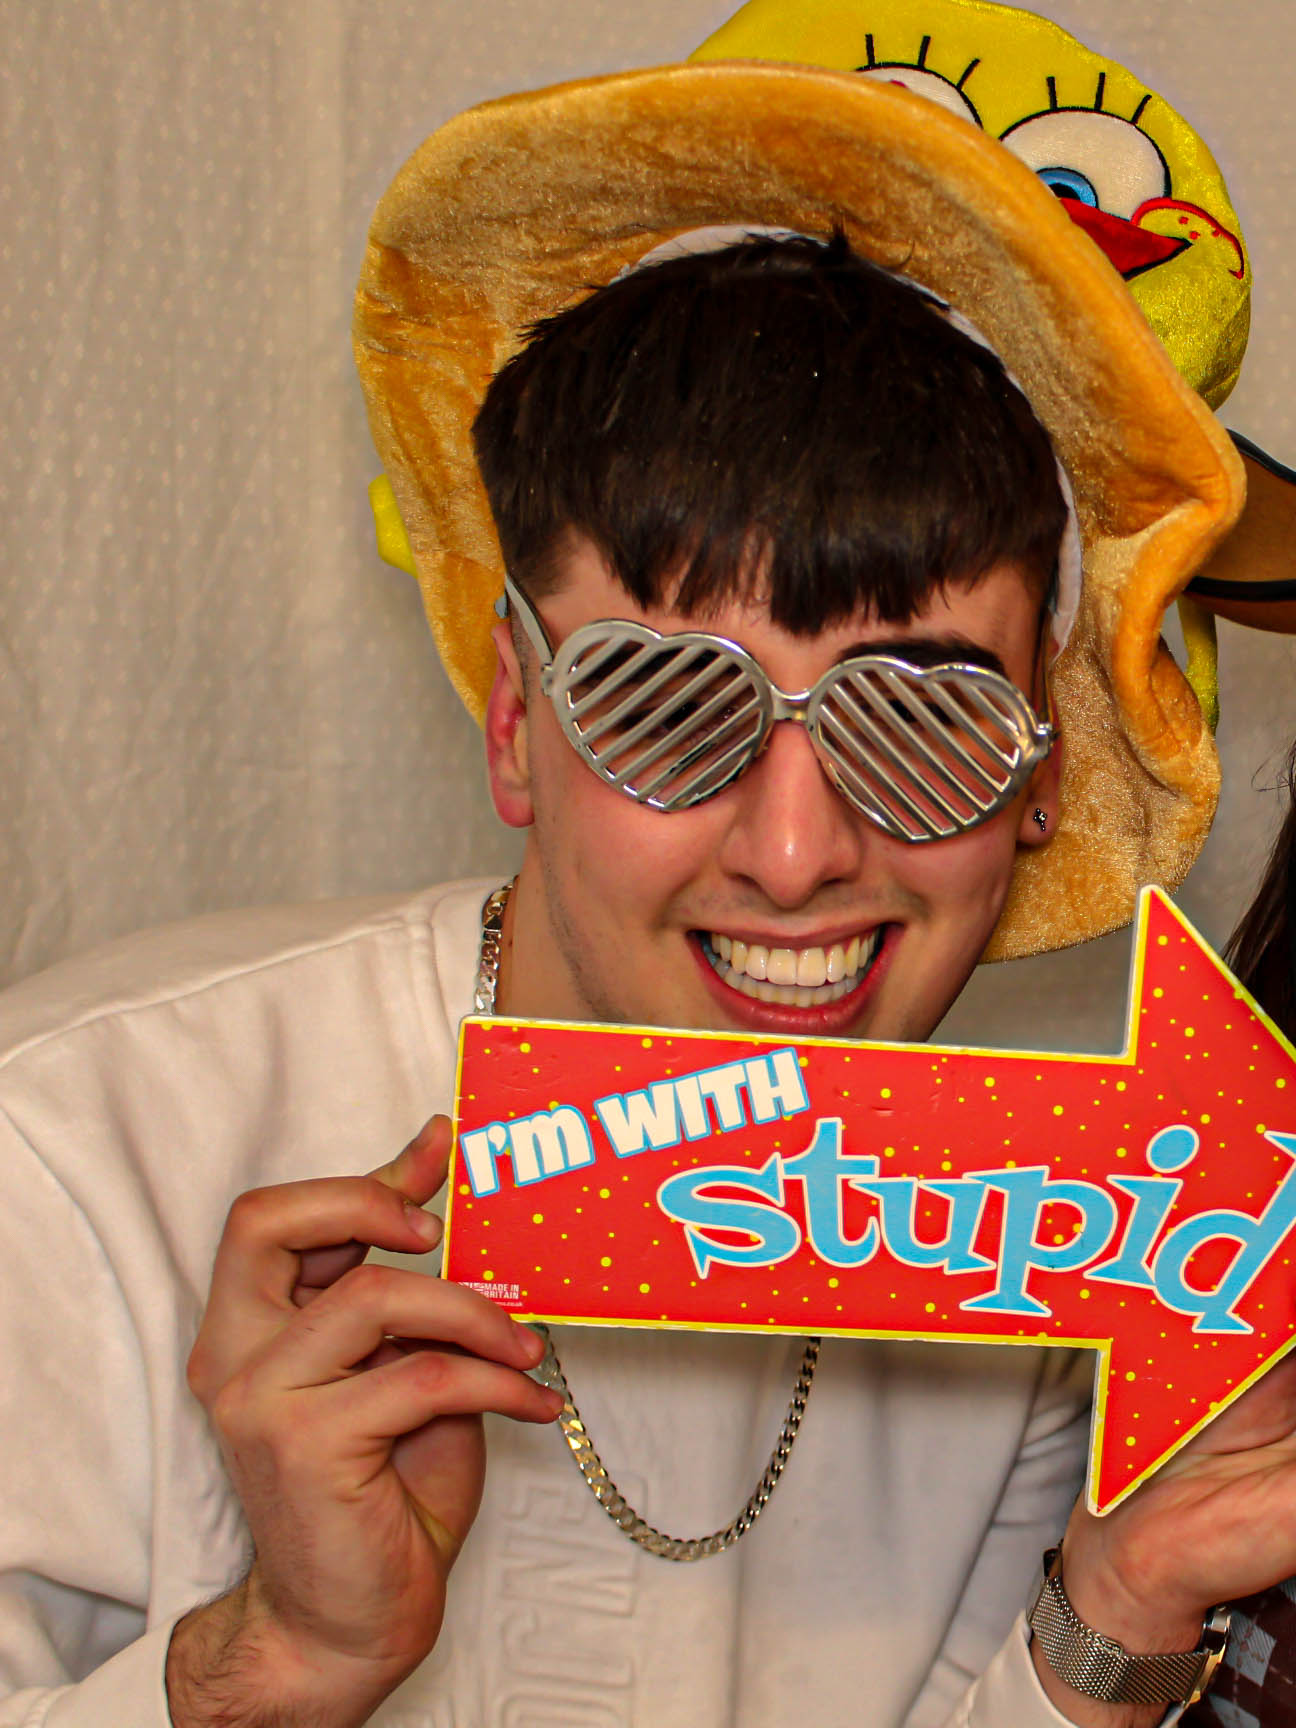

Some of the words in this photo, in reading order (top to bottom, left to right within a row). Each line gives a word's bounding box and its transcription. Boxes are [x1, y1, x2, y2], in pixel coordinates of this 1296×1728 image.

[594, 1047, 811, 1159] WITH
[483, 1282, 508, 1291] MADE
[510, 1283, 520, 1292] IN
